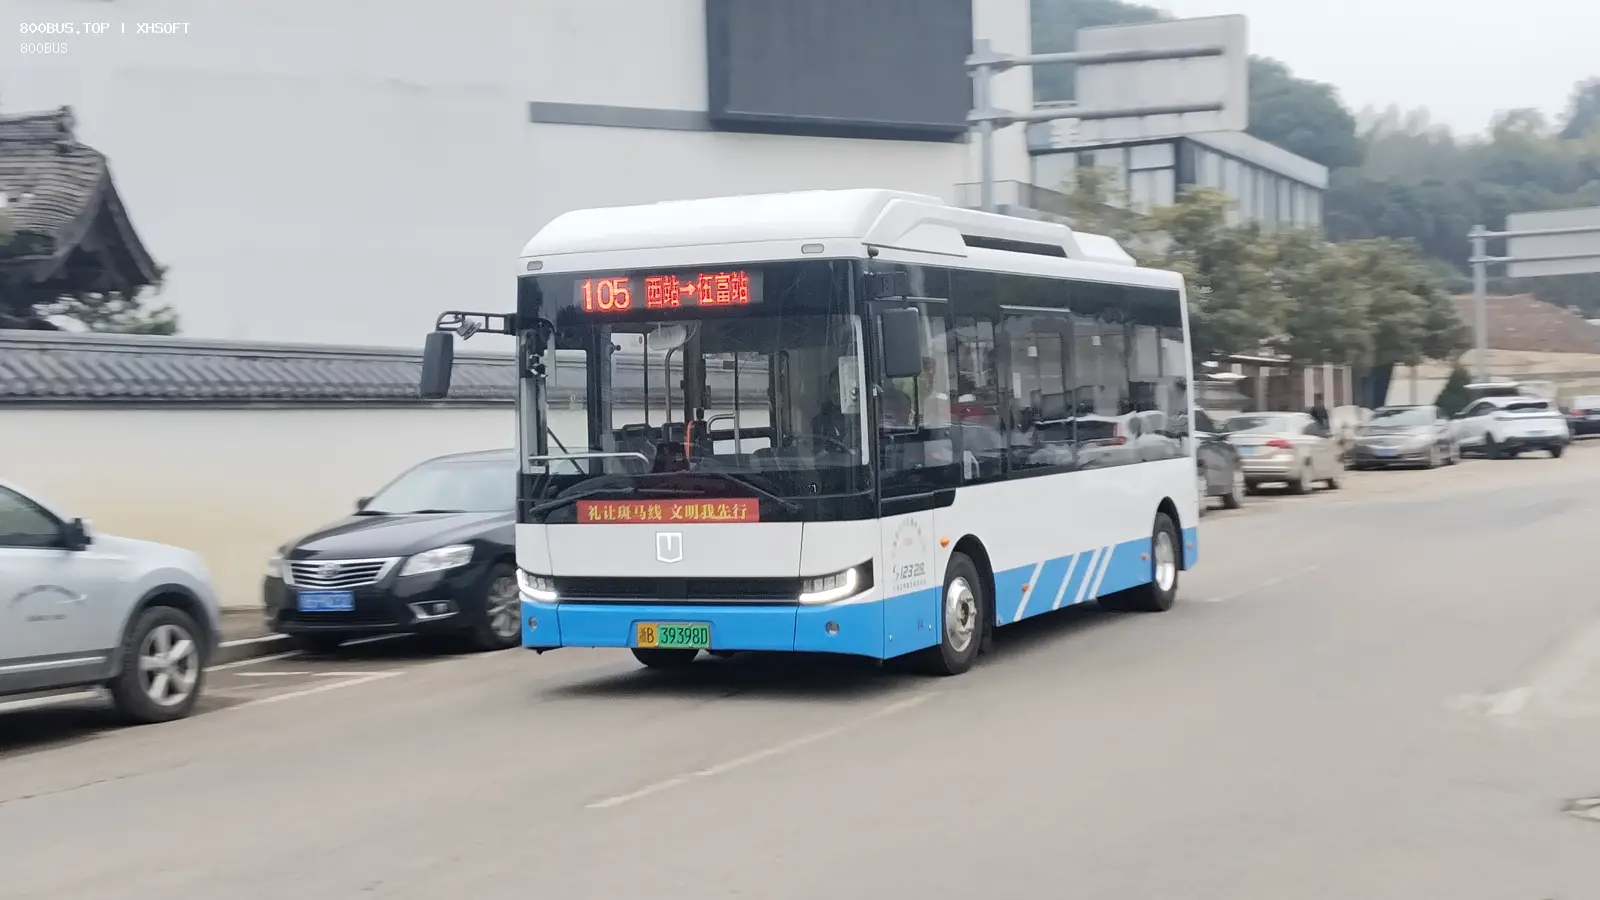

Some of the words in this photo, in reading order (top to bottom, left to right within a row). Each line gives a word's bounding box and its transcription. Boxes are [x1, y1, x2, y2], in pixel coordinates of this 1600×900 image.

[582, 277, 631, 312] 105
[645, 274, 680, 307] 西站
[698, 271, 749, 306] 伍富站
[588, 503, 663, 521] 礼让斑马线
[669, 503, 748, 520] 文明我先行
[660, 627, 708, 645] 39398D
